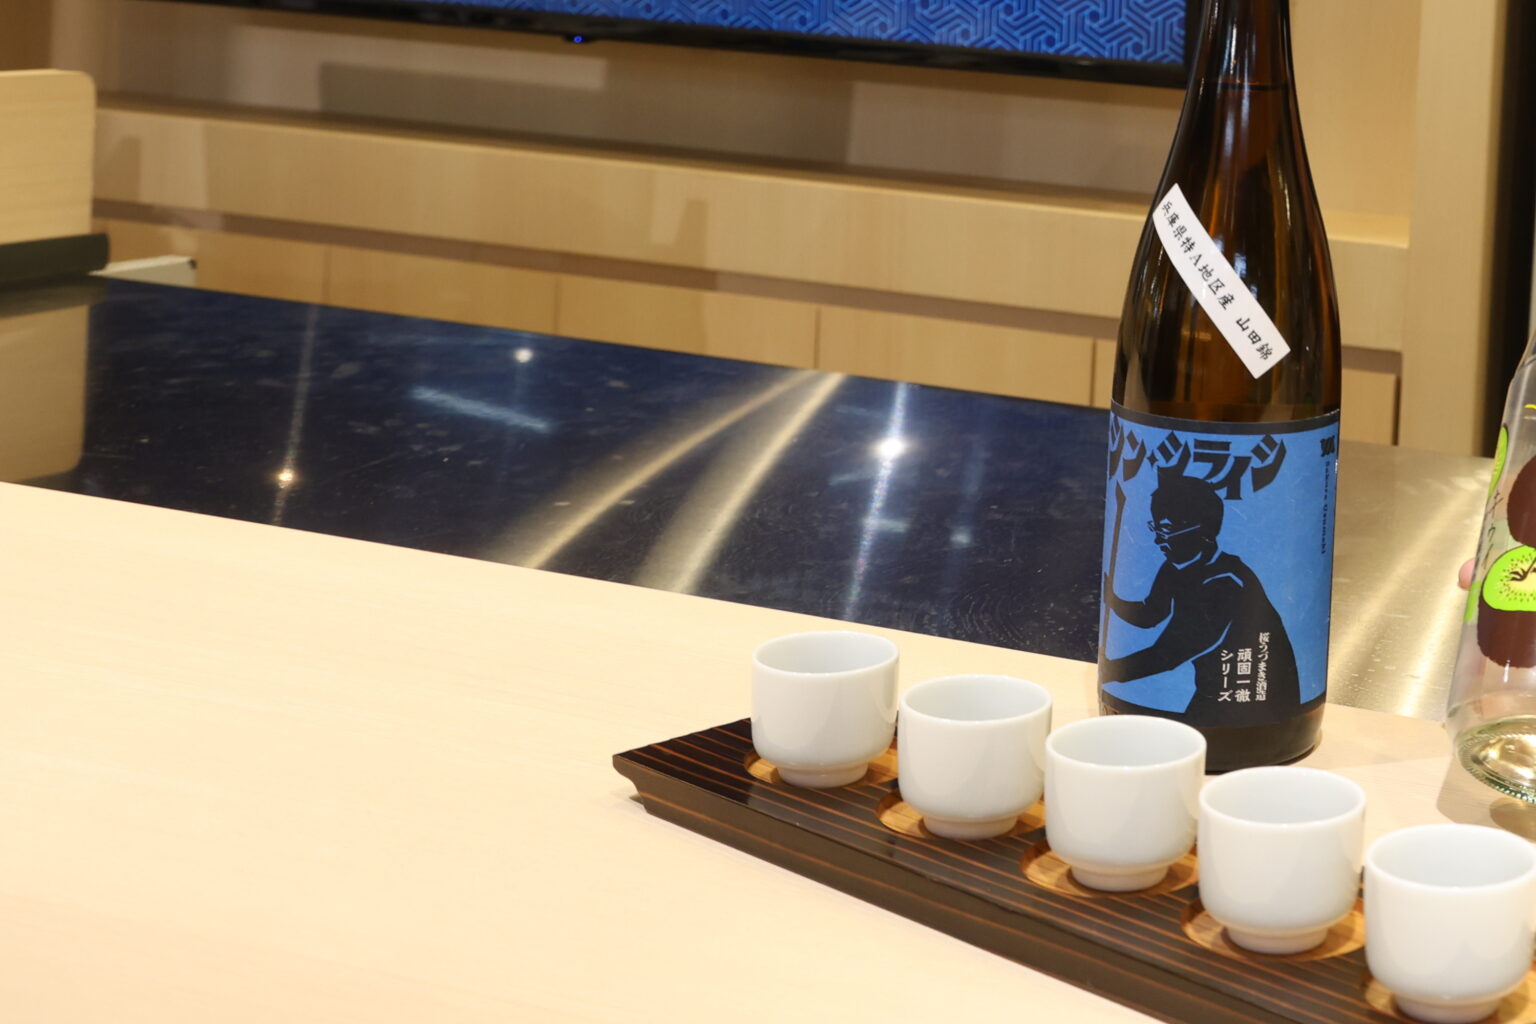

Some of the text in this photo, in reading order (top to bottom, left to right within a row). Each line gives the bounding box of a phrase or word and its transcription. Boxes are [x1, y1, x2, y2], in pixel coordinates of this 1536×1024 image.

[1236, 316, 1274, 361] 山田錦
[1217, 649, 1234, 702] シリーズ
[1235, 648, 1252, 703] 頑固一徹
